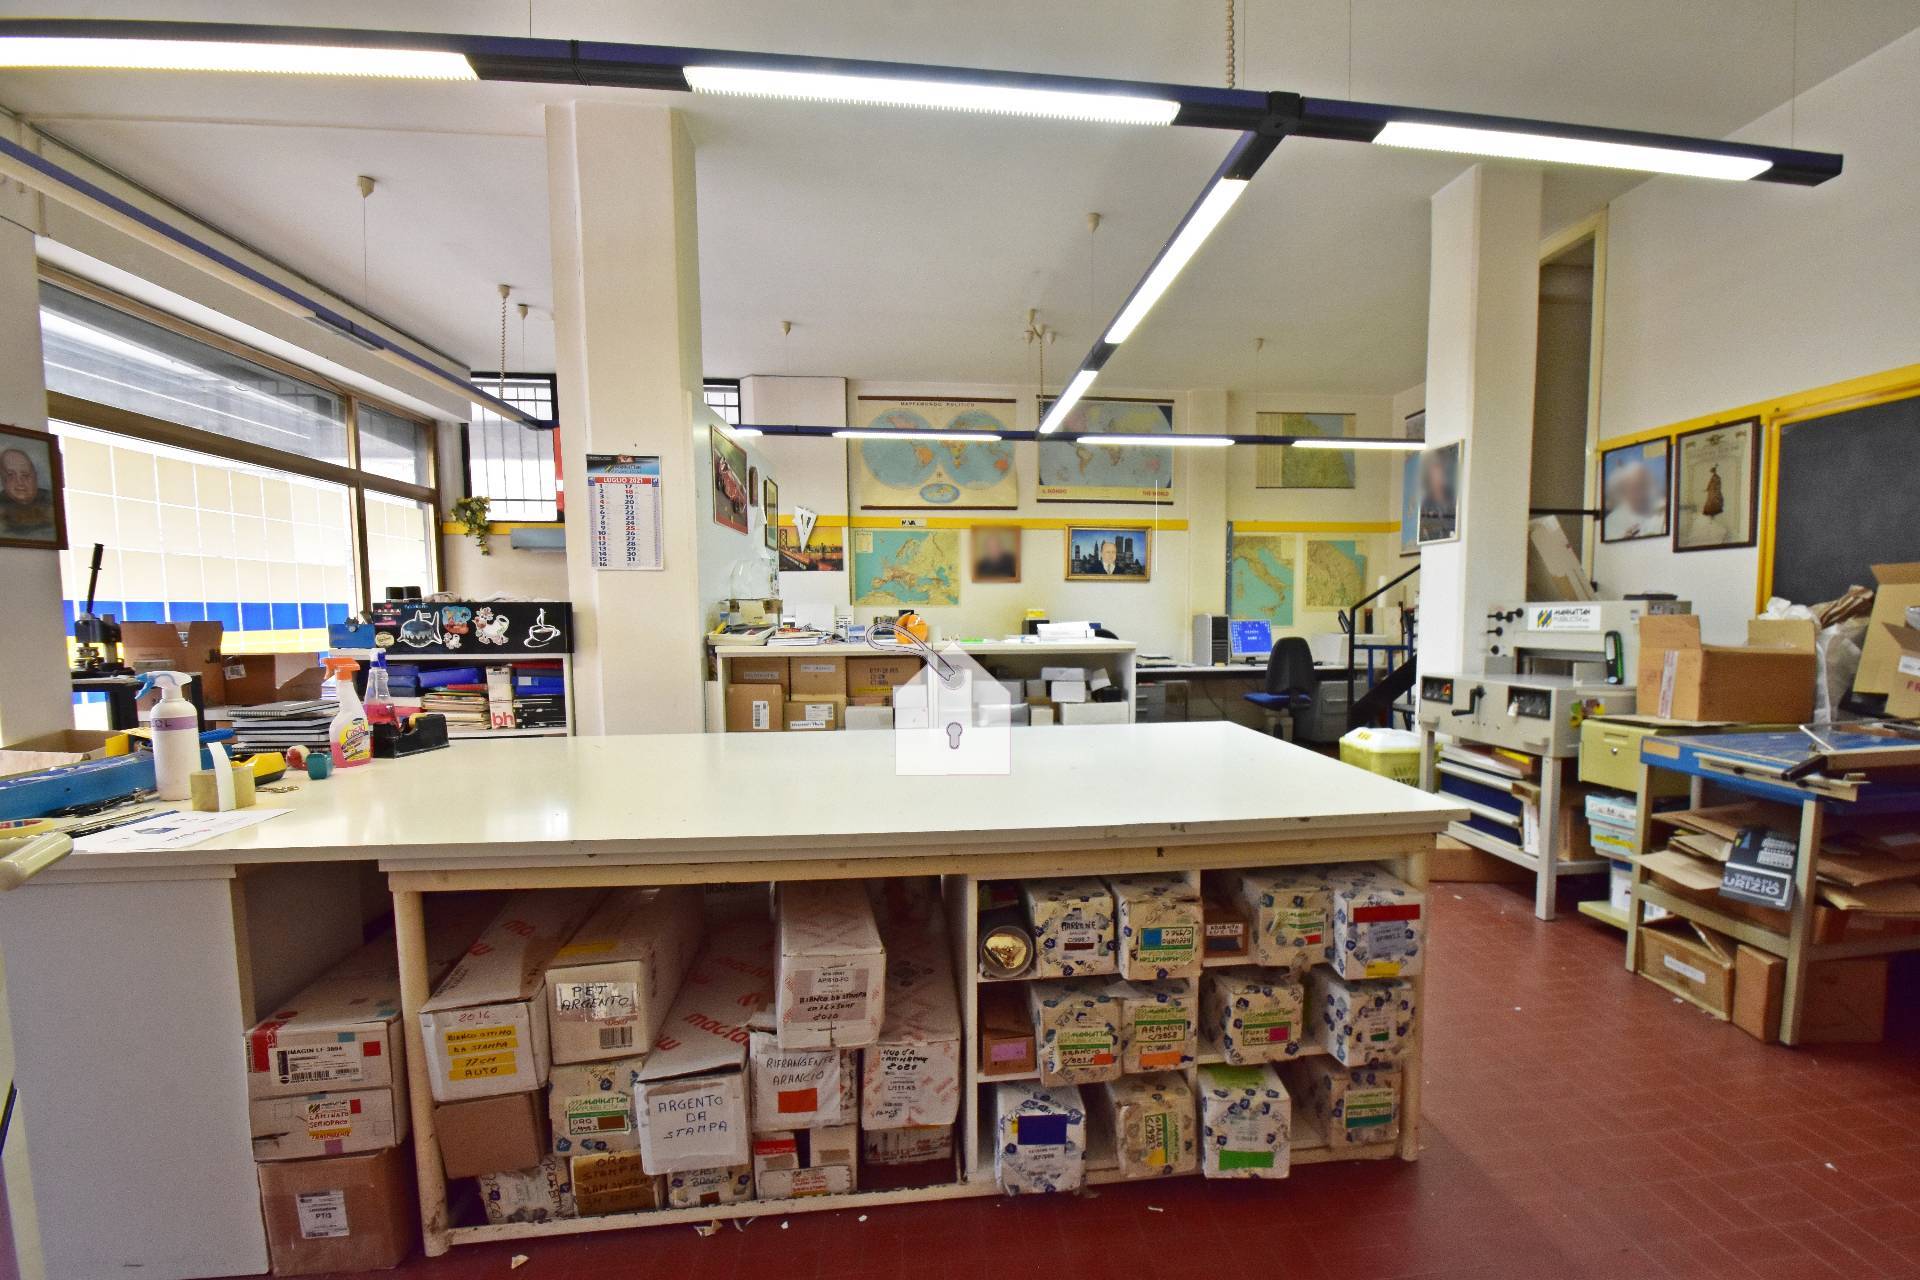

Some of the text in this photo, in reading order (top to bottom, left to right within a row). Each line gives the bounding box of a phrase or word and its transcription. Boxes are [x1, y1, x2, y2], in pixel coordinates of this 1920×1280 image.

[492, 711, 514, 727] bh
[571, 985, 608, 998] PET
[560, 994, 629, 1011] ARGENTO
[1141, 1023, 1183, 1035] ARANCIO
[772, 1070, 825, 1086] ARANCIO
[658, 1094, 724, 1113] ARGENTO
[572, 1118, 593, 1126] ORO
[685, 1111, 707, 1123] DA
[663, 1120, 728, 1140] STAMPA
[594, 1156, 627, 1169] ORO
